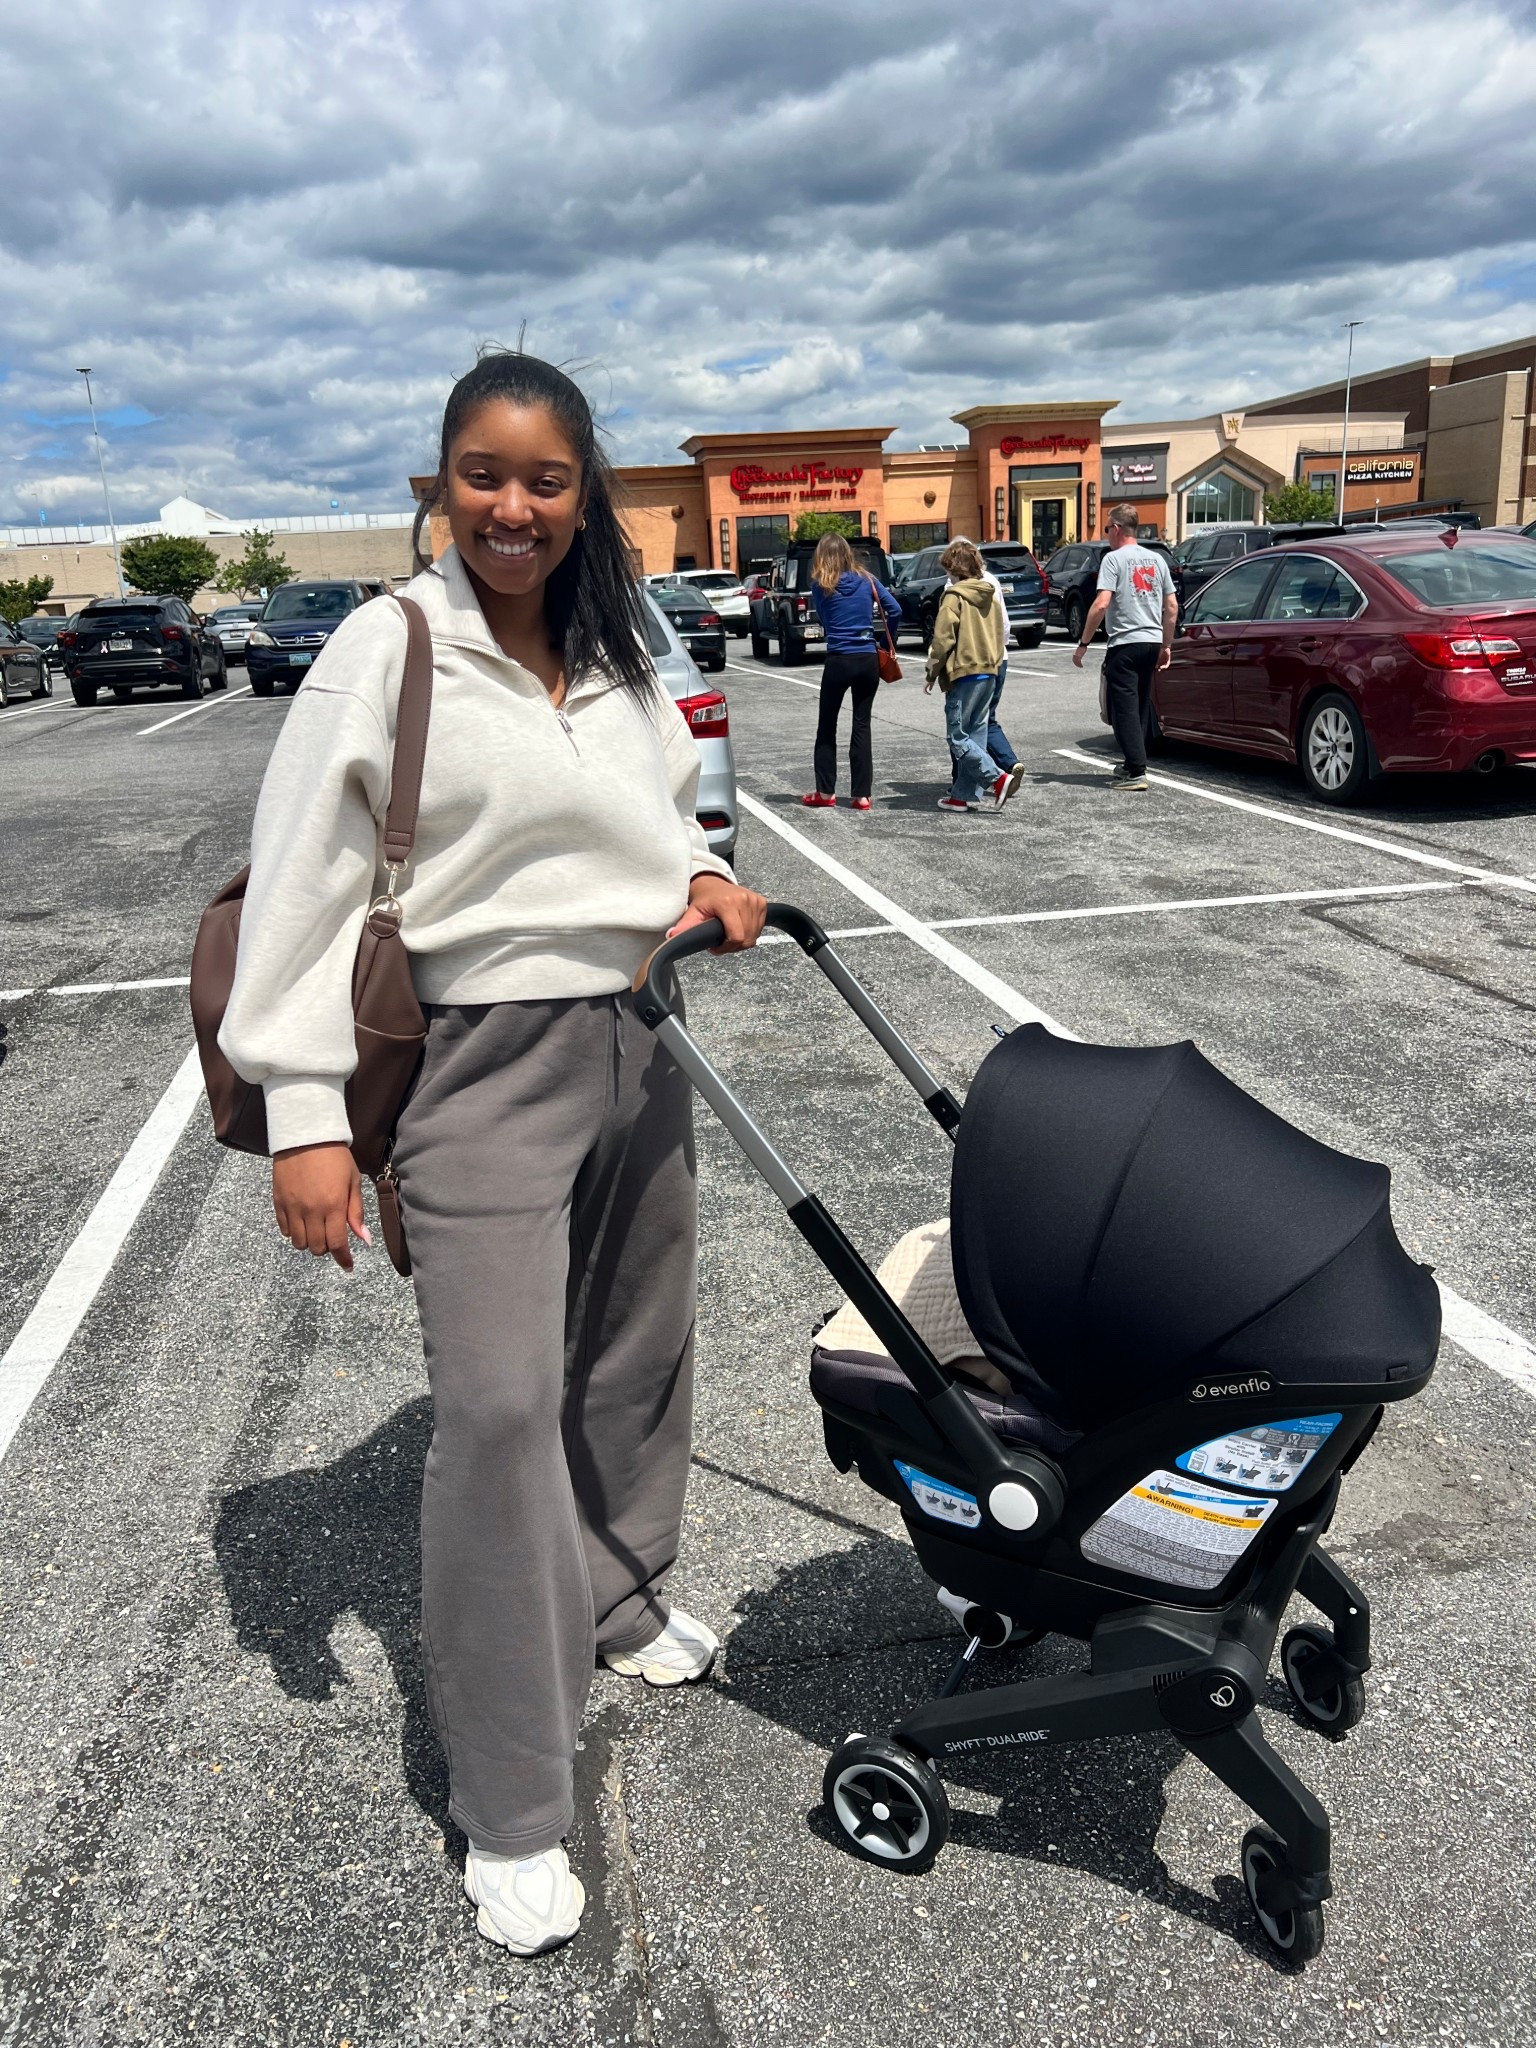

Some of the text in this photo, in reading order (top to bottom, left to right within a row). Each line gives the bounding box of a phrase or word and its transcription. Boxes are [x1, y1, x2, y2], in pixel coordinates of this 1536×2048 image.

[1349, 457, 1414, 472] california
[730, 464, 809, 492] Cheesecake
[802, 461, 864, 490] Factory
[1347, 471, 1412, 480] PIZZA KITCHEN
[1127, 558, 1158, 566] VOLUNTEER
[1209, 1378, 1271, 1397] evenflo
[1152, 1495, 1194, 1515] WARNING!
